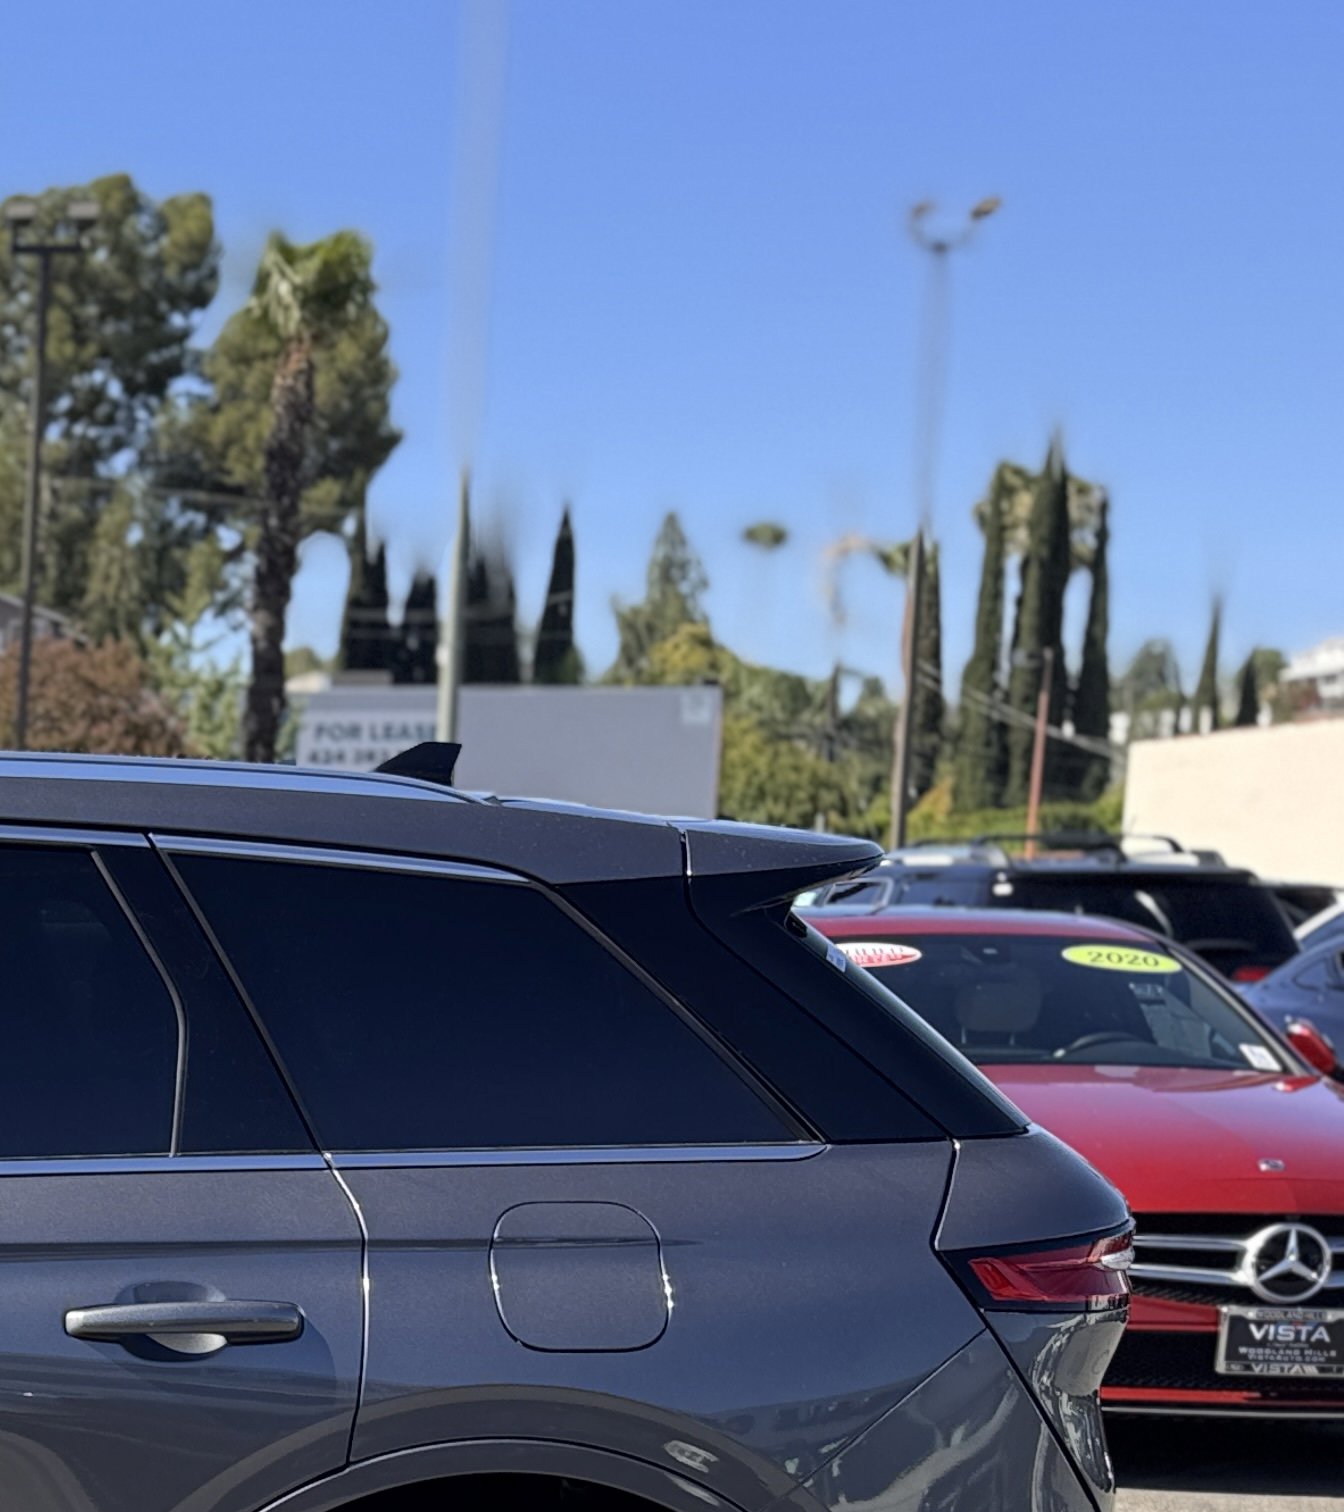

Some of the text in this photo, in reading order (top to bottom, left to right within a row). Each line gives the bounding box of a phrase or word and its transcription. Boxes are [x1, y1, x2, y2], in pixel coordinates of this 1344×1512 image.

[315, 722, 361, 742] FOR
[1087, 951, 1160, 967] 2020
[1249, 1323, 1331, 1342] VISTA
